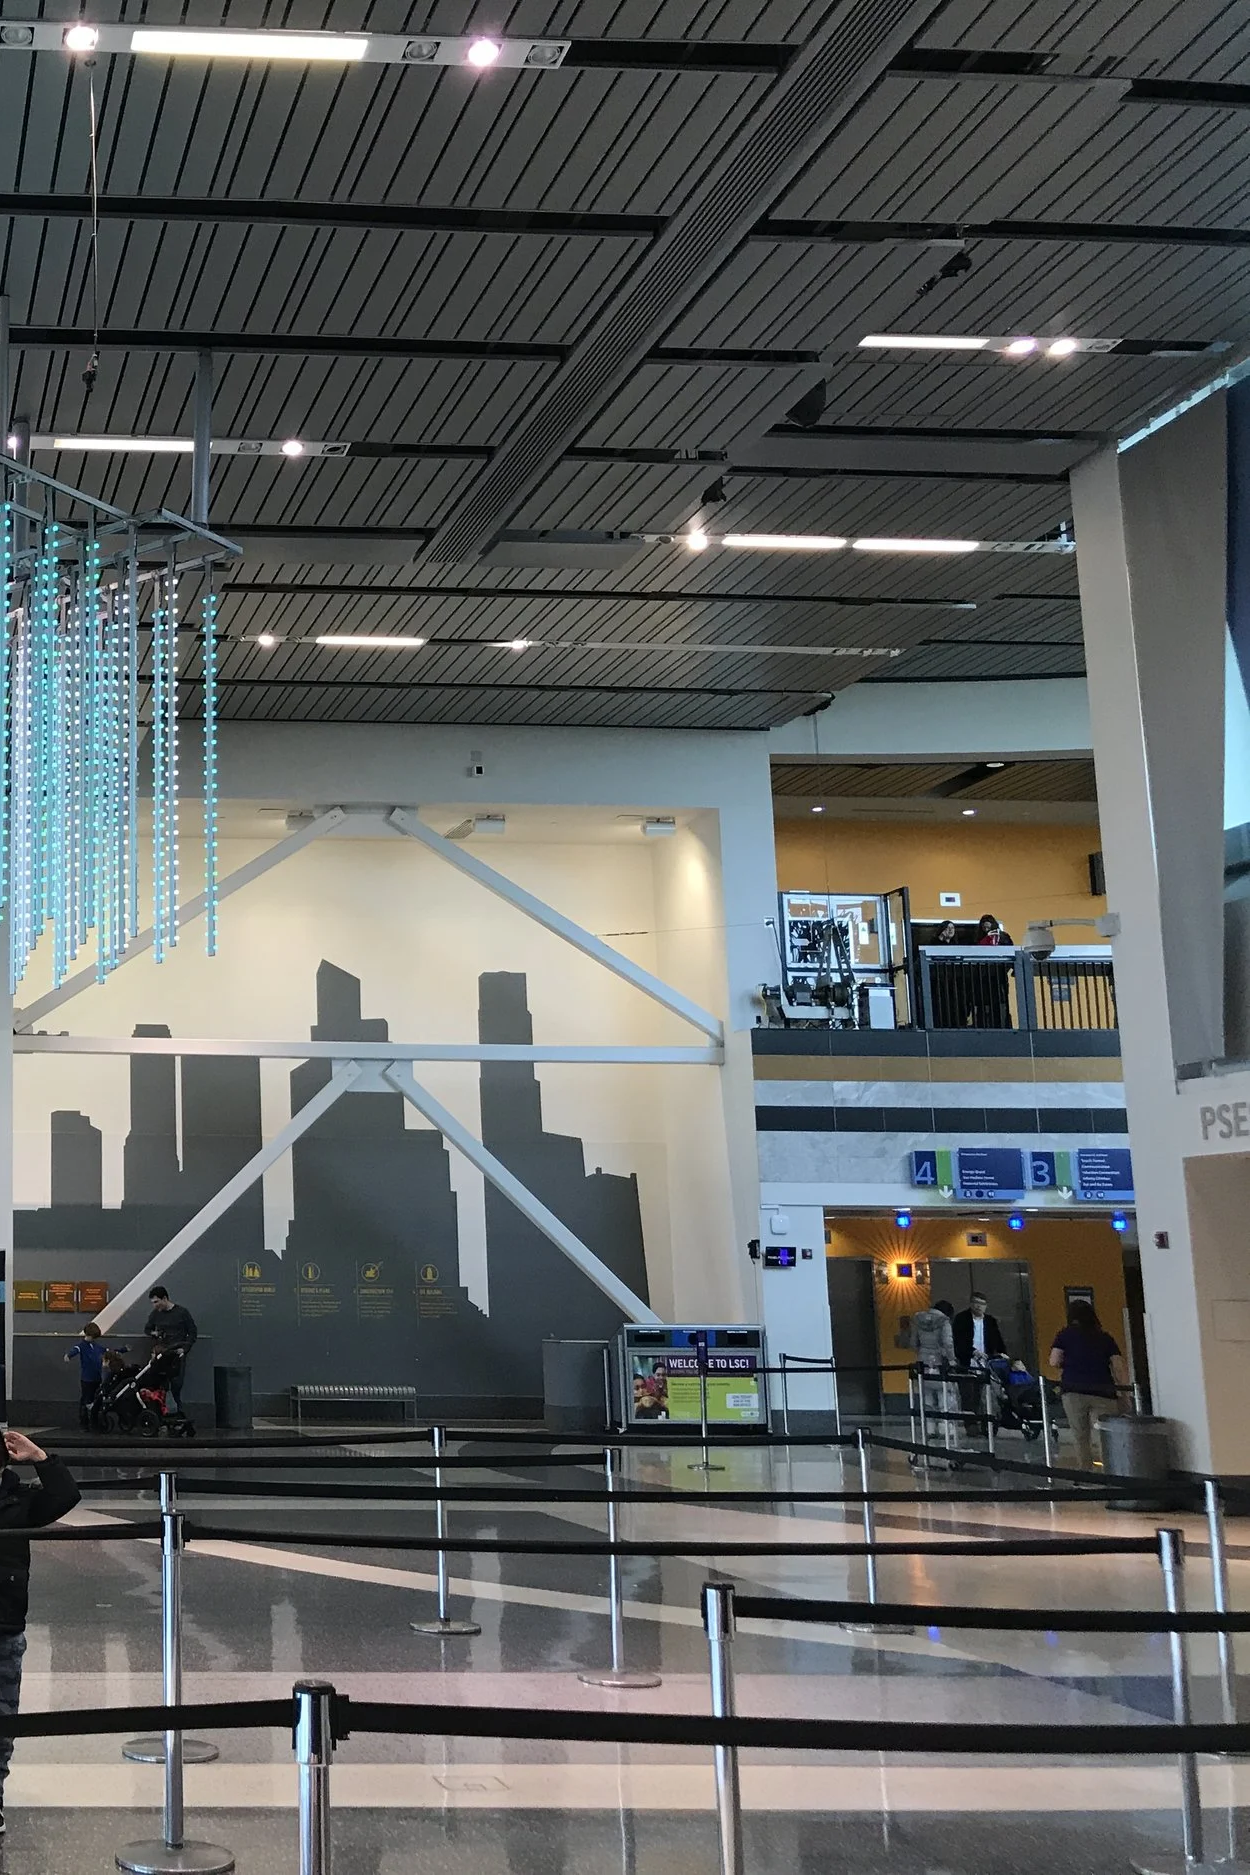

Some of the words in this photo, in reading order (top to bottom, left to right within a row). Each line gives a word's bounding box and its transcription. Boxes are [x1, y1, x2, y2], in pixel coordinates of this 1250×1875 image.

[1200, 1102, 1250, 1140] PSE
[916, 1161, 934, 1185] 4
[1032, 1160, 1050, 1186] 3
[669, 1359, 714, 1369] WELCOE
[715, 1359, 727, 1369] TO
[729, 1359, 749, 1369] LSC!
